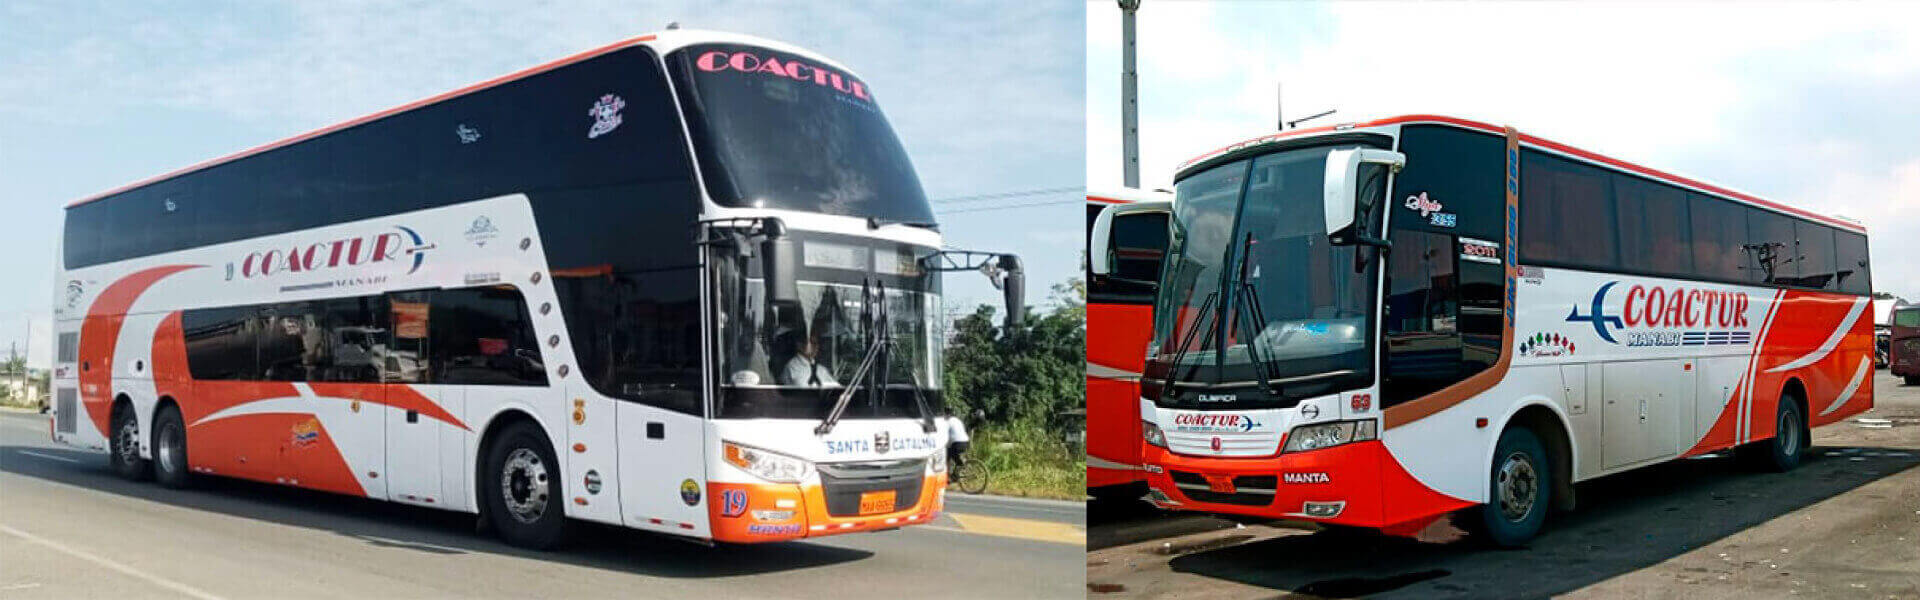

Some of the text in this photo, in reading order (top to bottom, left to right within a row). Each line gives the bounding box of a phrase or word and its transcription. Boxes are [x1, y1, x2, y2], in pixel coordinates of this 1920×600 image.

[696, 51, 870, 102] COACTUR
[241, 231, 403, 279] COACTUR
[1623, 284, 1750, 329] COACTUR
[1627, 331, 1682, 347] MANABI
[1174, 413, 1241, 428] COACTUR
[825, 439, 870, 454] SANTA
[1283, 472, 1330, 484] MANTA
[722, 488, 748, 518] 19
